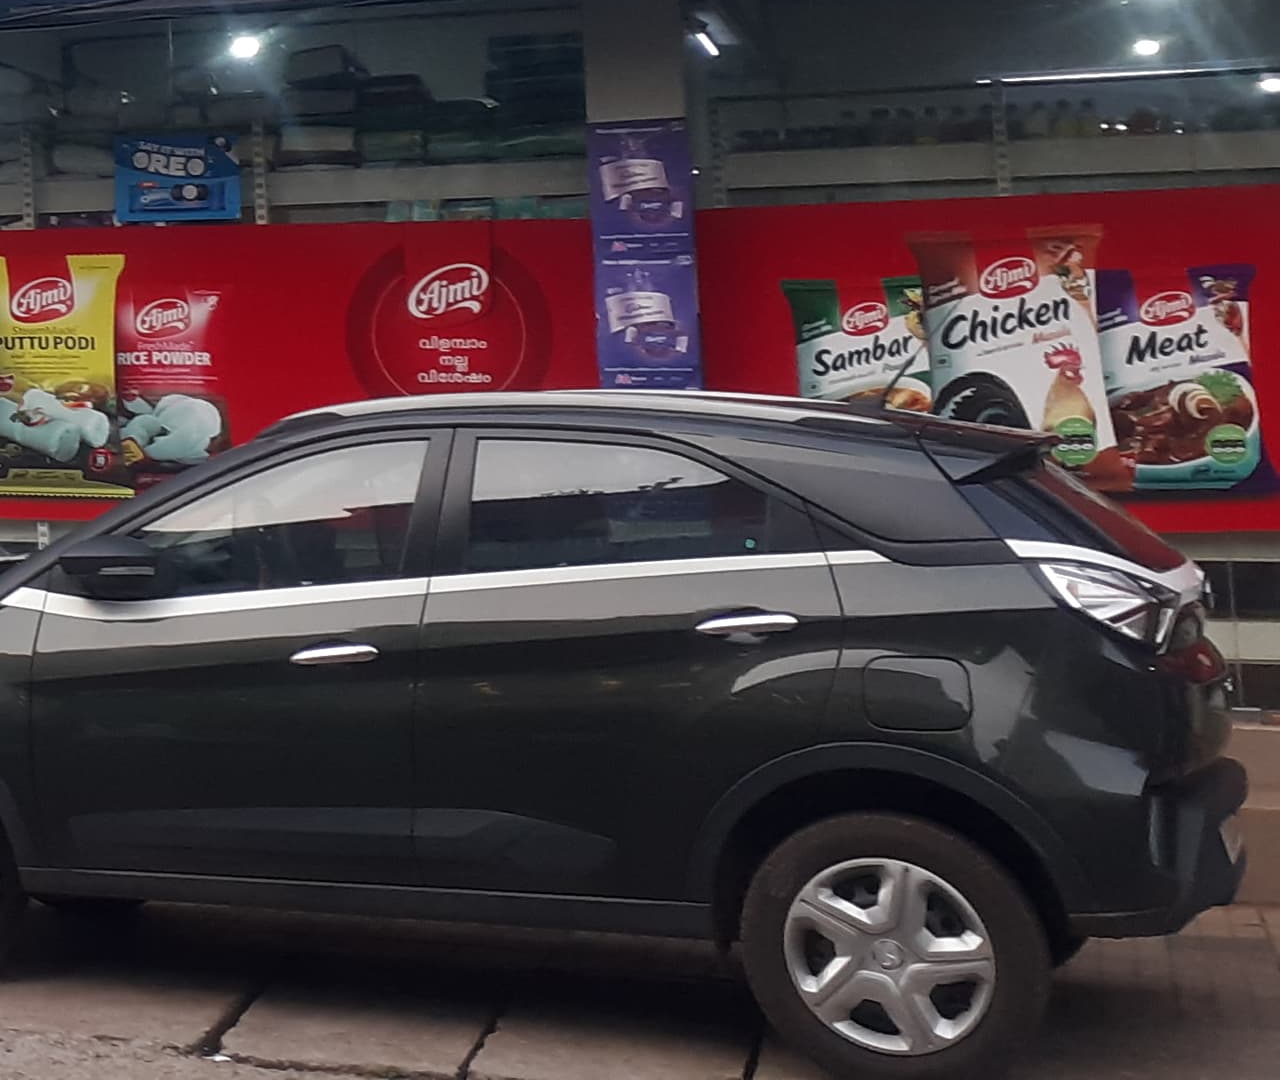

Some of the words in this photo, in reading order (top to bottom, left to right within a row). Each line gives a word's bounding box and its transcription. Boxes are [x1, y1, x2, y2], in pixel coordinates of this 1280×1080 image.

[131, 151, 206, 177] OREO
[415, 267, 486, 315] Ajmi
[983, 260, 1034, 292] Ajmi
[15, 278, 71, 318] Ajmi
[141, 301, 188, 332] Ajmi
[941, 296, 1070, 350] Chicken
[54, 336, 96, 351] PODI
[117, 351, 149, 366] RICE
[152, 351, 212, 366] POWDER
[811, 334, 913, 377] Sambar
[1125, 323, 1209, 366] Meat
